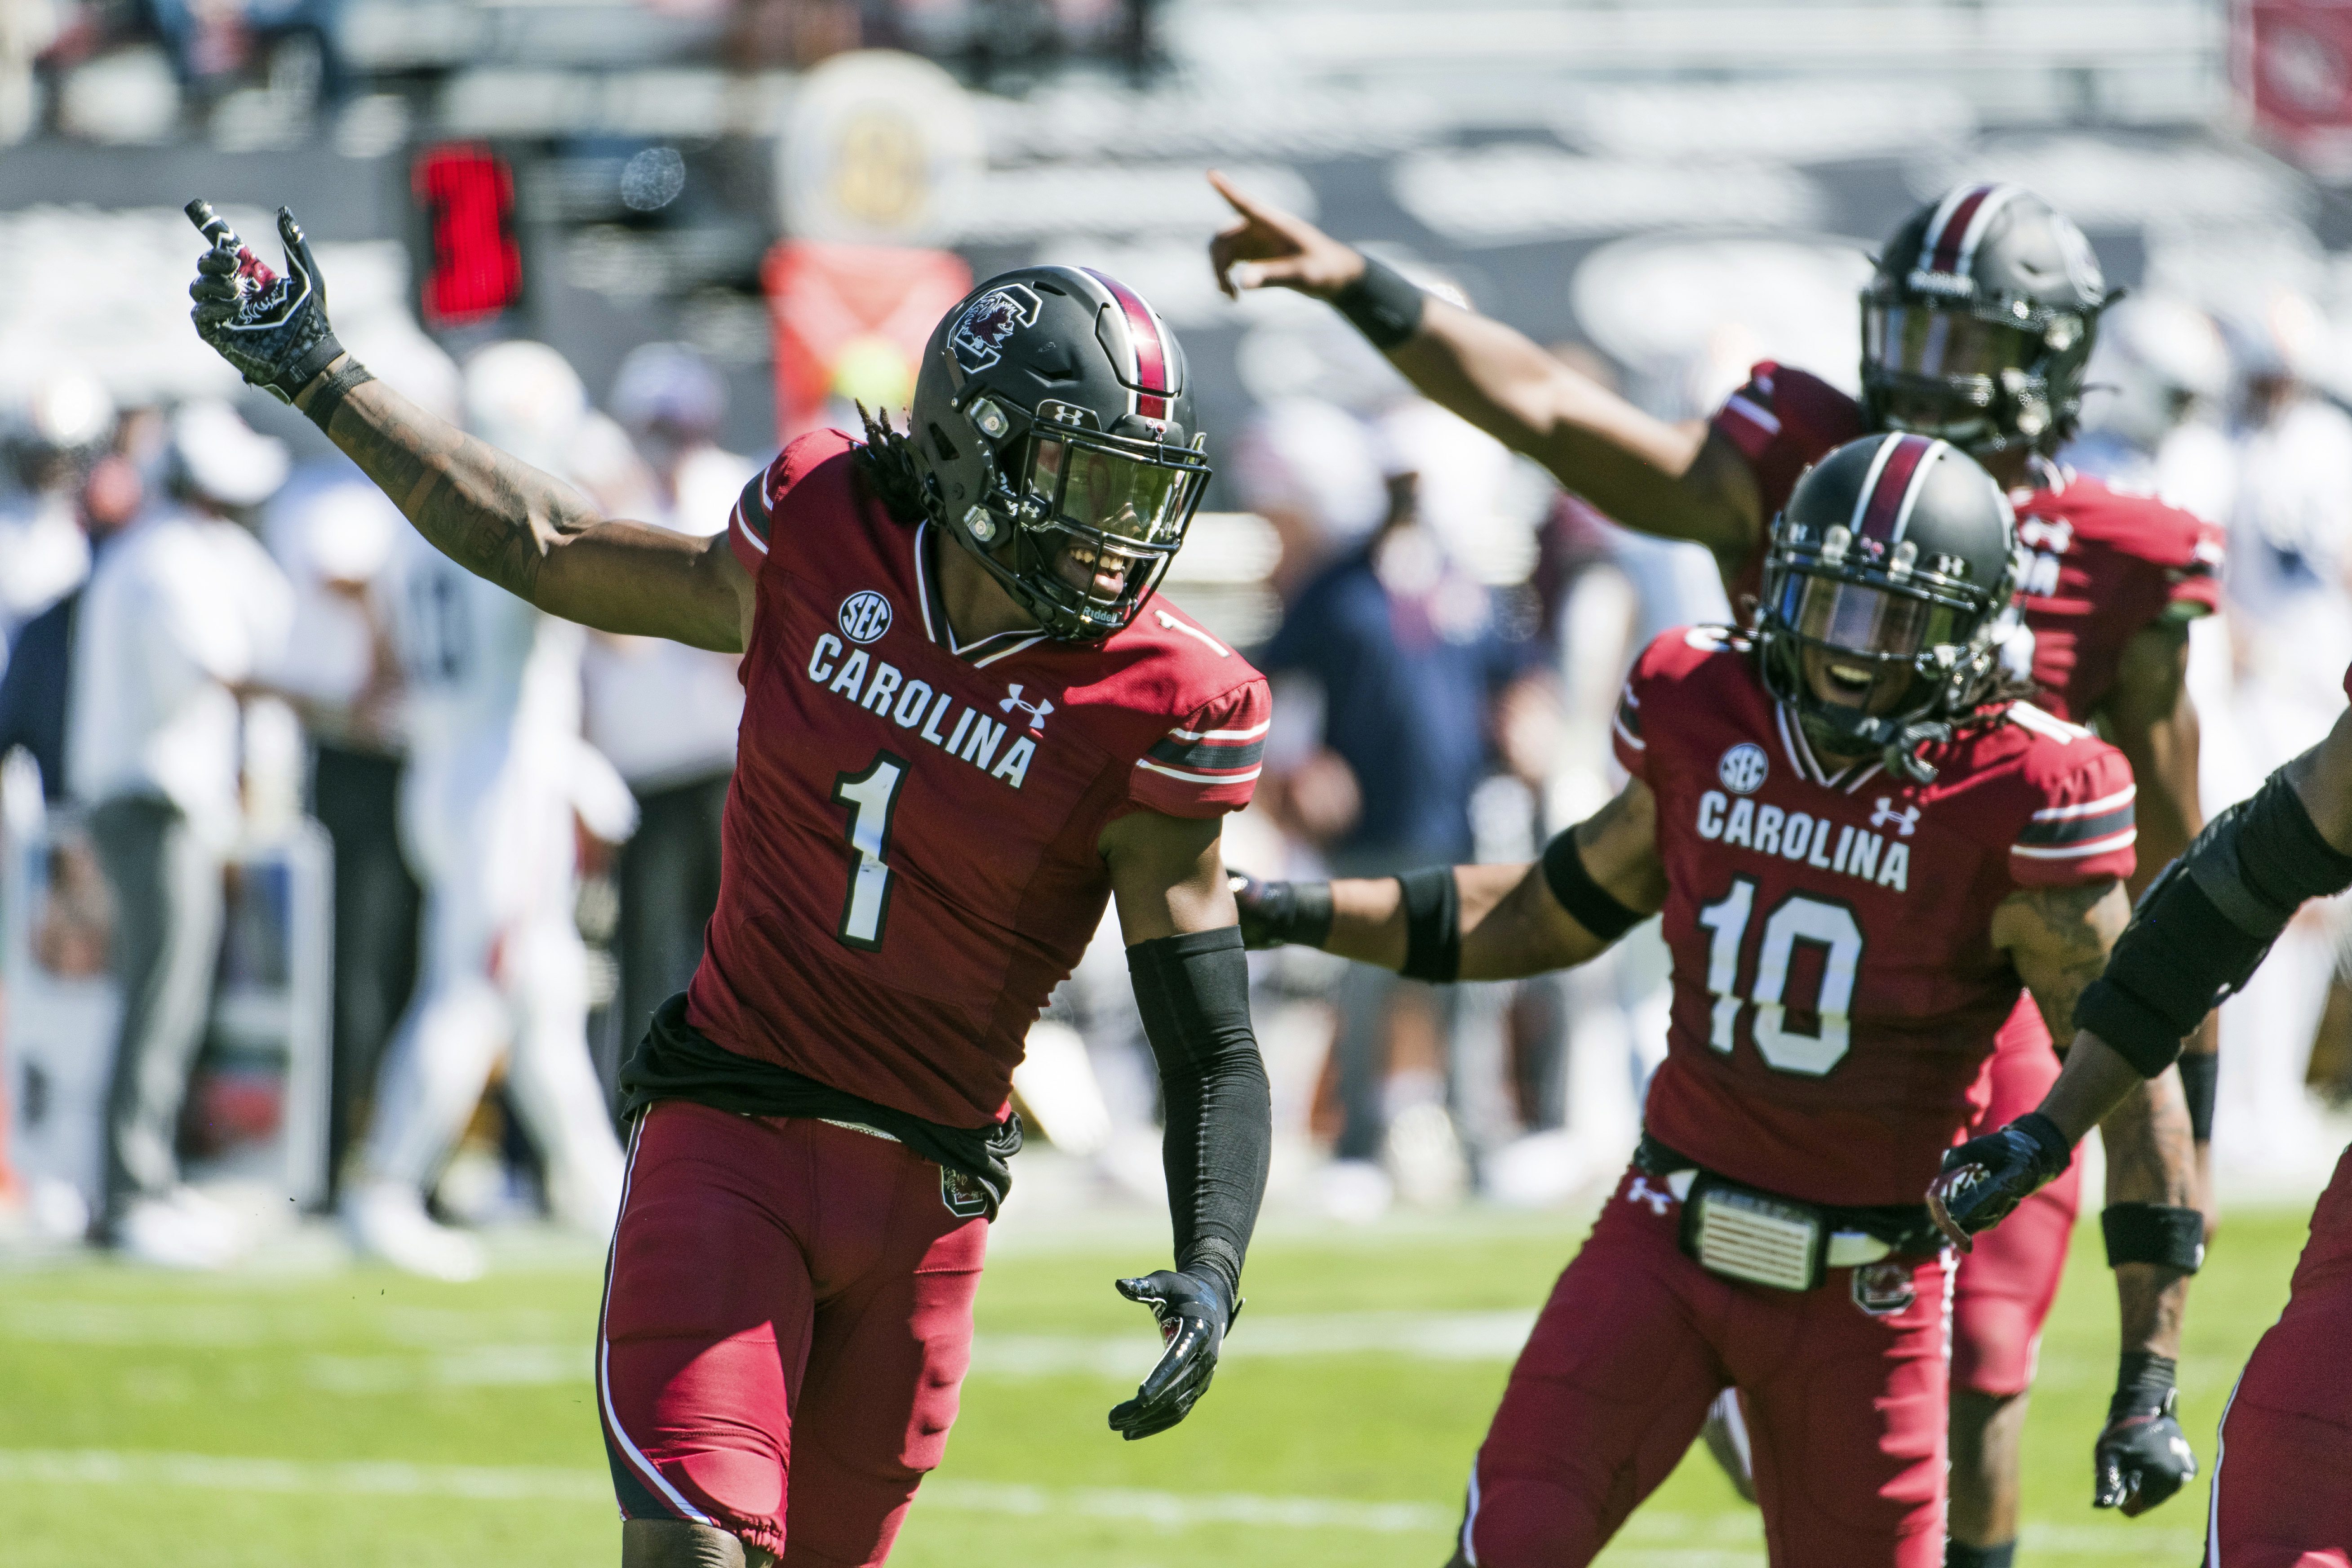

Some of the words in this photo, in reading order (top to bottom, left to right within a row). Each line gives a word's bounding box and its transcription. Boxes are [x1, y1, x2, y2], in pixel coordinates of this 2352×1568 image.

[841, 593, 890, 641] SEC
[1082, 605, 1118, 623] Riddell
[1153, 609, 1233, 658] 1
[808, 632, 1036, 790] CAROLINA
[1722, 745, 1766, 792] SEC
[835, 753, 907, 948] 1
[1696, 790, 1910, 892] CAROLINA
[1699, 876, 1865, 1078] 10
